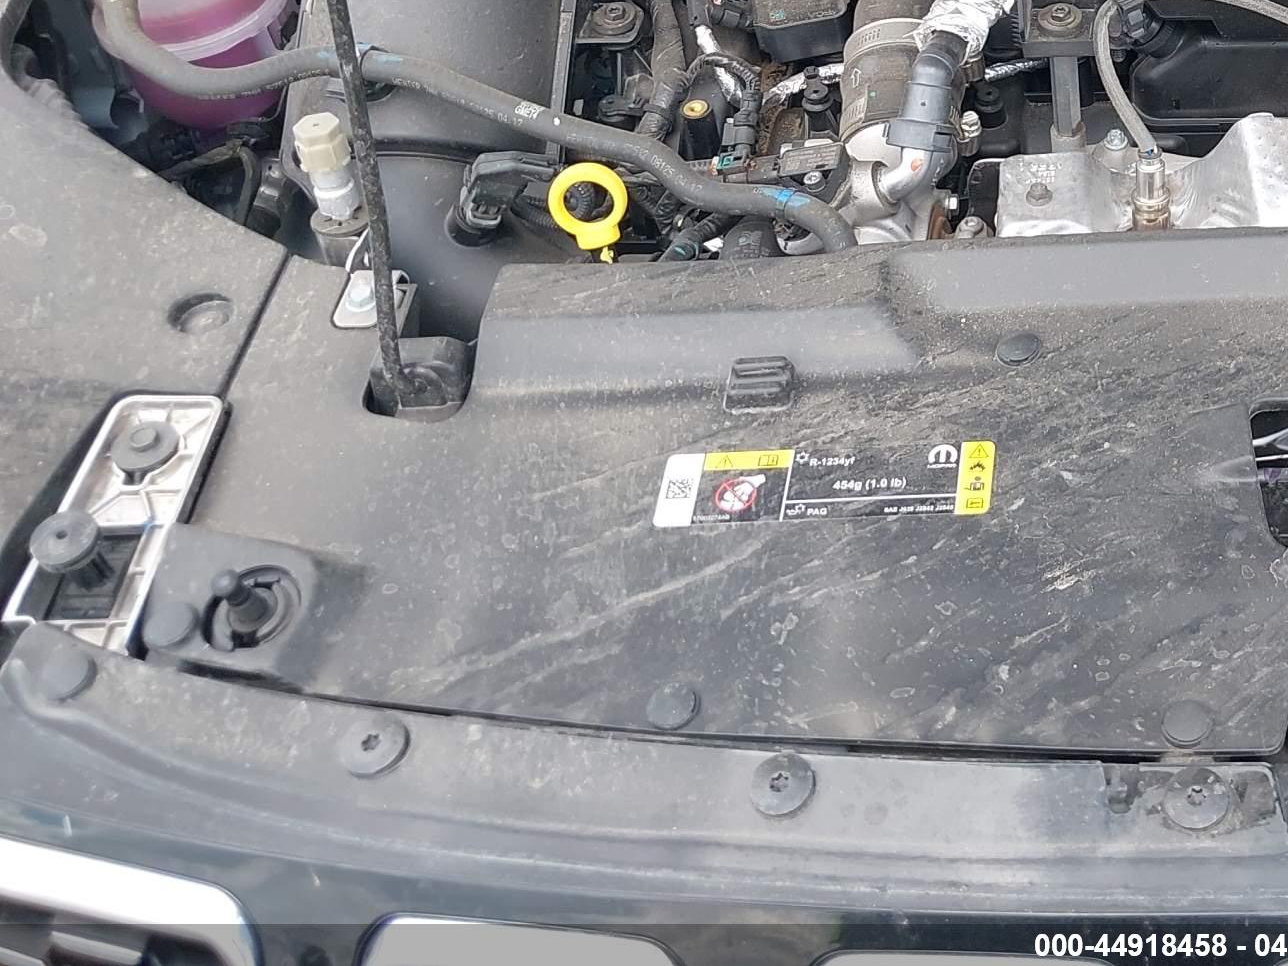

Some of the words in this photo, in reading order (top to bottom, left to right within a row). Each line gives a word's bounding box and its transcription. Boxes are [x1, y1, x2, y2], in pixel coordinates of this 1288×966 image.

[809, 456, 856, 467] R-1234yf
[832, 480, 863, 491] 454g
[865, 479, 888, 491] (1.0
[890, 477, 907, 489] lb)
[806, 507, 828, 516] PAG
